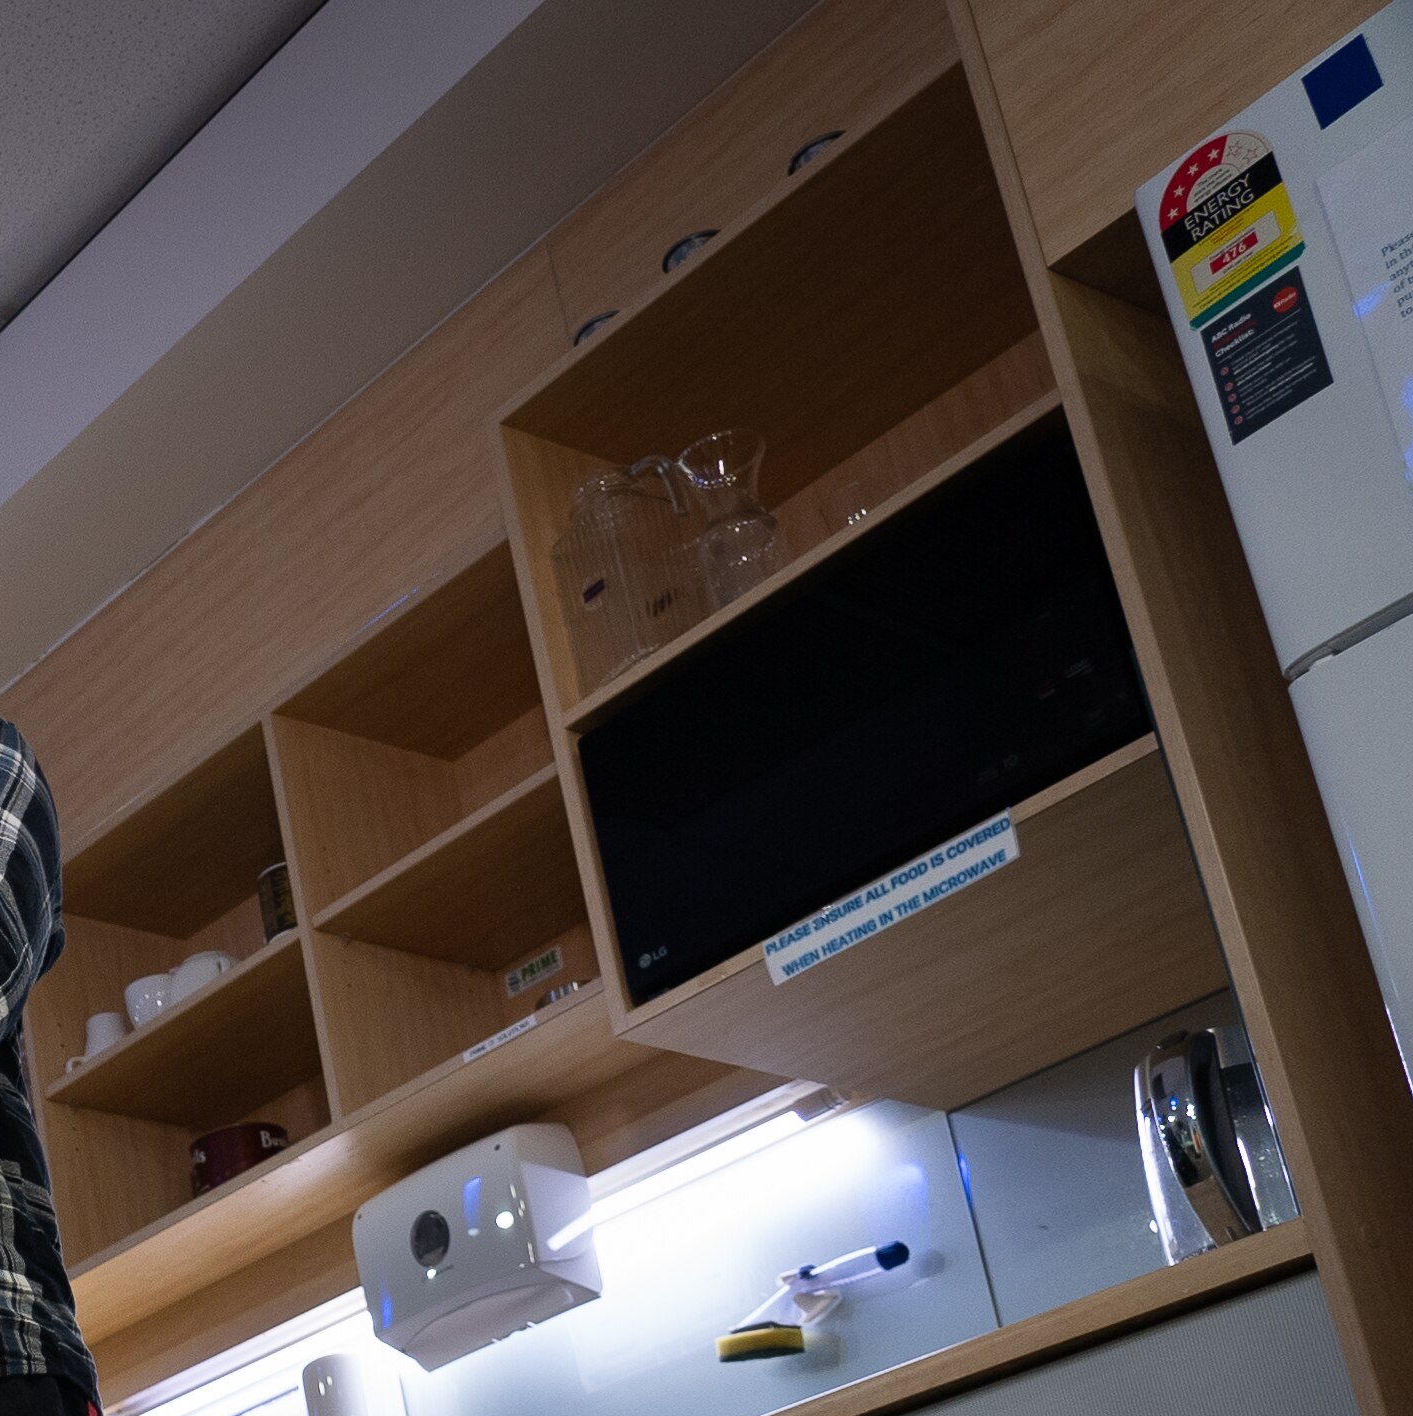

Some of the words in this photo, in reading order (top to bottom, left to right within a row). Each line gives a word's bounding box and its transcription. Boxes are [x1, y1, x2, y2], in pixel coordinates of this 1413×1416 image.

[1184, 173, 1250, 230] ENERGY
[1192, 188, 1255, 242] RATING
[1223, 242, 1247, 264] 476
[1386, 258, 1397, 270] in
[1394, 278, 1406, 293] of
[764, 924, 811, 957] PLEASE
[813, 897, 865, 931] ENSURE
[865, 885, 889, 905] ALL
[891, 862, 928, 891] FOOD
[930, 853, 945, 869] IS
[946, 817, 1011, 859] COVERED
[782, 950, 821, 977] WHEN
[823, 919, 878, 955] HEATING
[879, 910, 894, 926] IN
[895, 895, 921, 917] THE
[923, 849, 1007, 903] MICROWAVE
[521, 950, 559, 981] PRIME
[652, 946, 668, 961] LG
